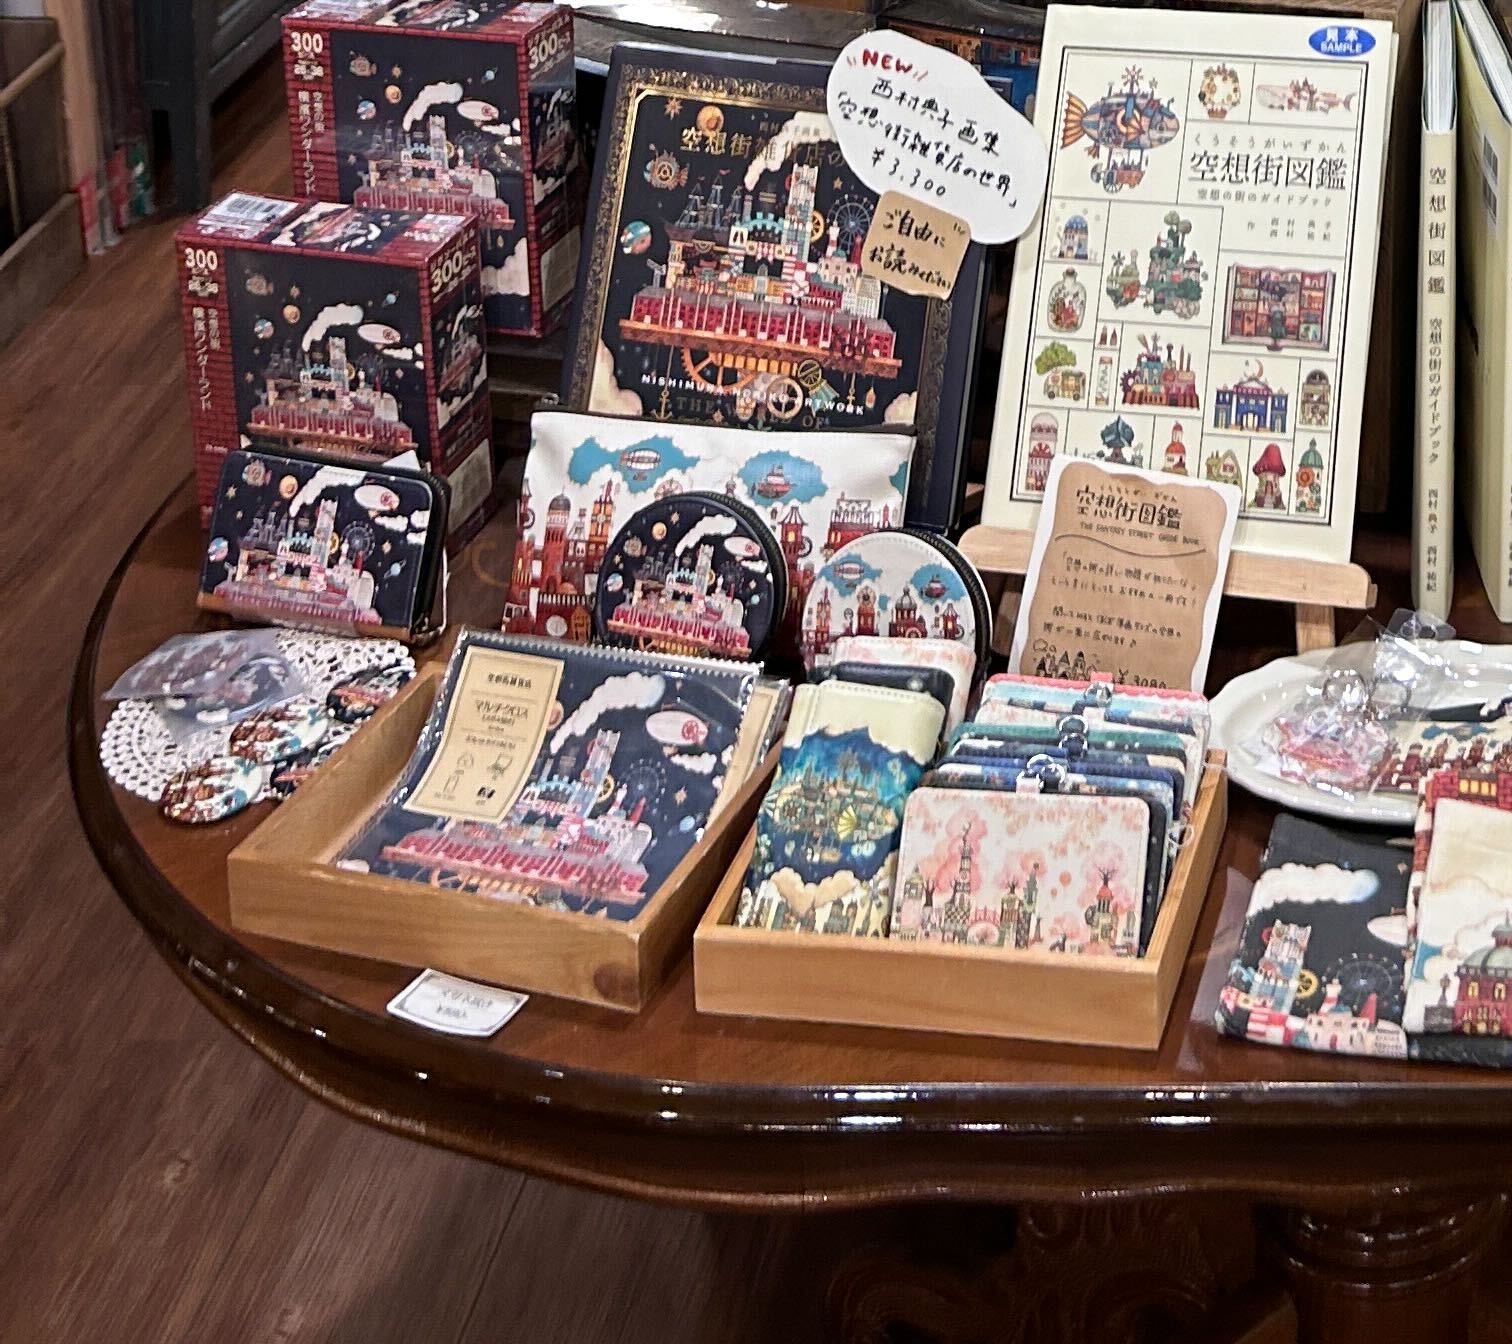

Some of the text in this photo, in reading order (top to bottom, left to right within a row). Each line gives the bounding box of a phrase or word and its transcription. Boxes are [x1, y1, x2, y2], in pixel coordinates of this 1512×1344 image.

[290, 31, 324, 53] 300
[1319, 40, 1363, 54] SAMPLE
[1325, 27, 1360, 42] 見本
[862, 48, 914, 73] NEW
[838, 91, 1018, 210] 「空想街雑貨店の世界」
[1194, 133, 1347, 154] くうそうがいずかん
[1188, 149, 1348, 191] 空想街図鑑
[1197, 188, 1332, 207] 空想の街のガイドブック
[882, 208, 946, 249] ご自由に
[1427, 165, 1448, 296] 空想街図鑑
[184, 247, 218, 271] 300
[1427, 316, 1444, 465] 空想の街のガイドブック
[1076, 484, 1183, 531] 空想街図鑑
